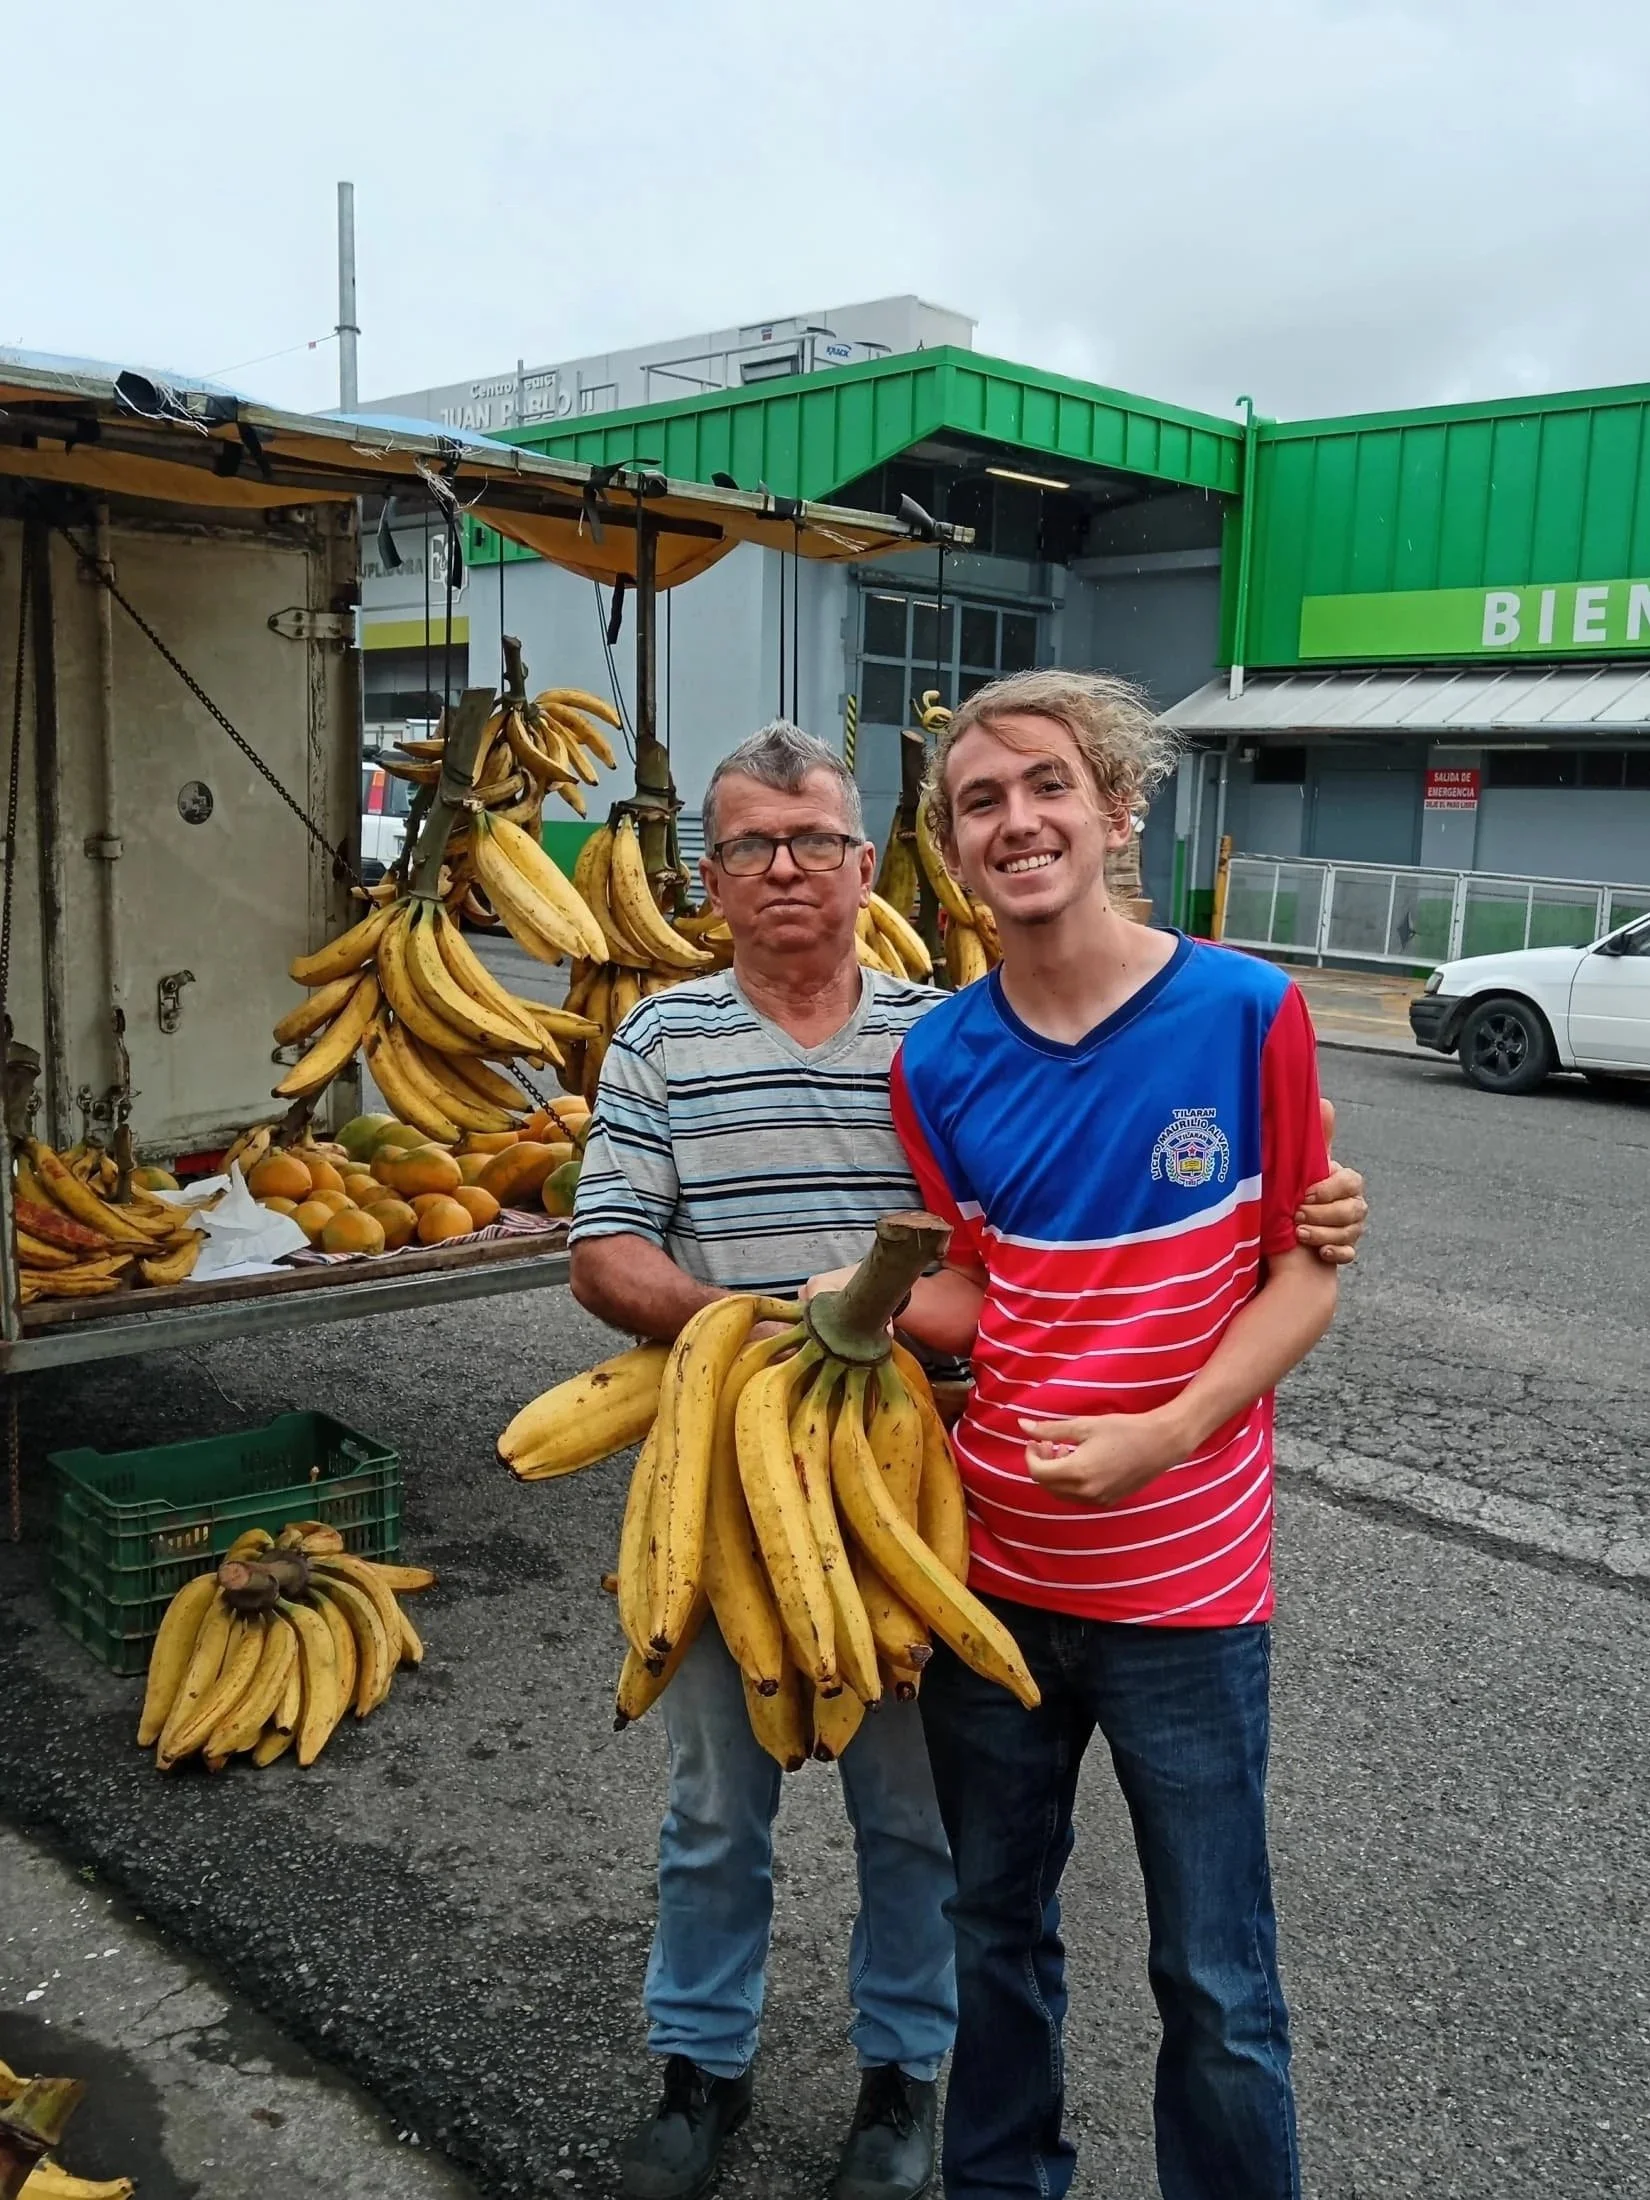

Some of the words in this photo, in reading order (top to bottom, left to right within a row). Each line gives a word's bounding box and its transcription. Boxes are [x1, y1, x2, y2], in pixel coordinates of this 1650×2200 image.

[440, 403, 491, 430] JUAN
[1434, 772, 1459, 782] SALIDA
[1461, 772, 1472, 782] DE
[1427, 786, 1475, 798] EMERGENCIA
[1173, 1108, 1216, 1118] TILARAN
[1151, 1144, 1162, 1180] LICEO
[1159, 1118, 1208, 1145] MAURILIO
[1208, 1125, 1229, 1181] ALVARADO
